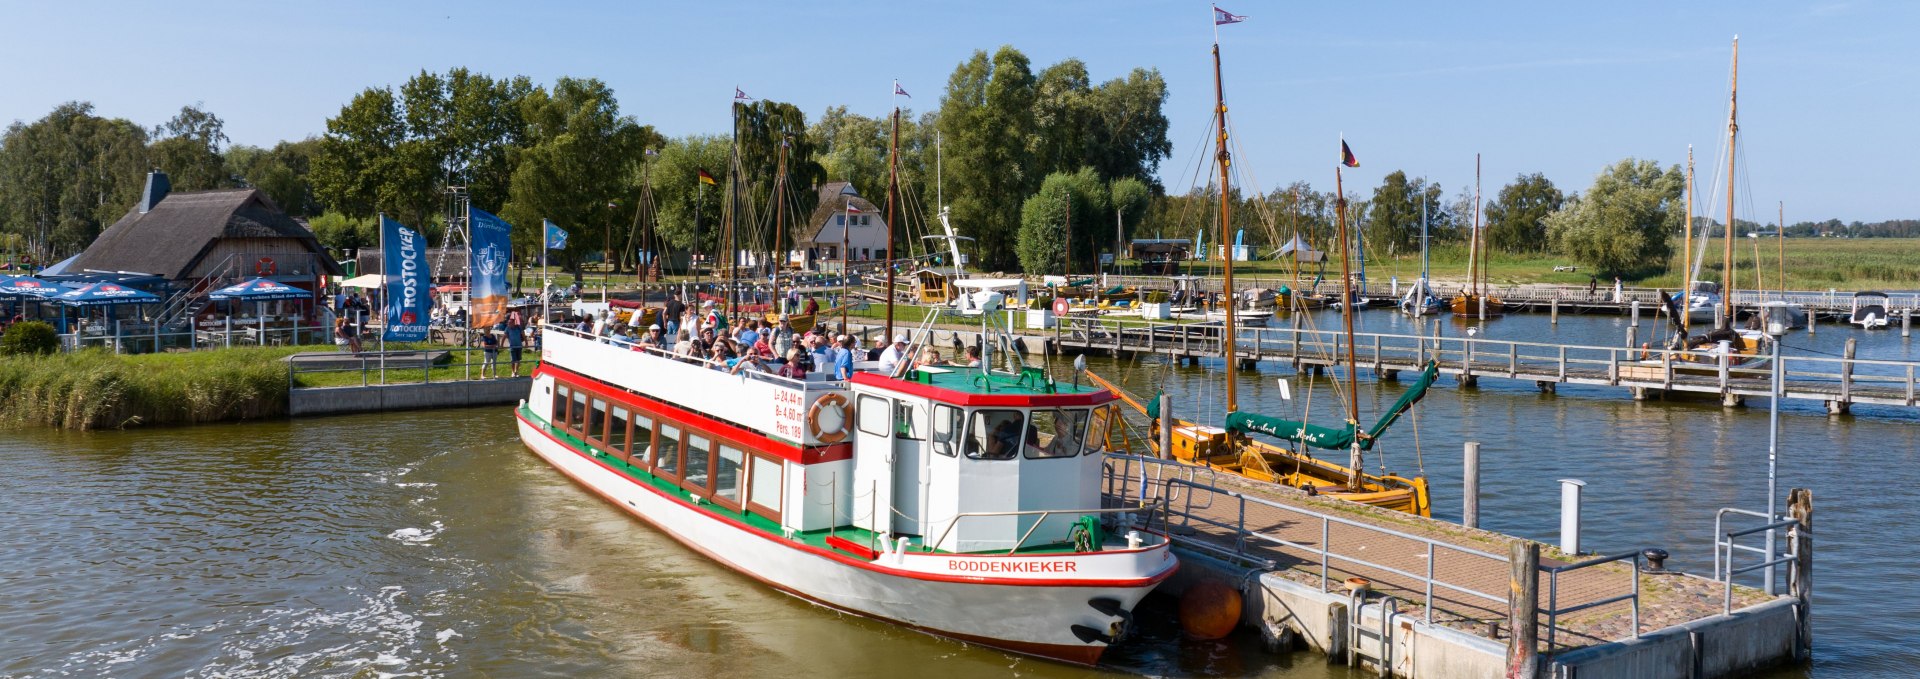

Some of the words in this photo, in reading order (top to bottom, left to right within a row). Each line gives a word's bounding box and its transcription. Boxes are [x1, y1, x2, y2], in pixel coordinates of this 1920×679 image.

[398, 226, 418, 308] ROSTOCKER
[774, 389, 780, 400] L=
[781, 390, 796, 405] 24,44
[798, 397, 802, 406] m
[775, 405, 782, 416] B=
[783, 407, 796, 420] 4,60
[797, 413, 802, 422] m
[777, 421, 789, 435] Pers.
[791, 425, 801, 439] 189
[948, 560, 1077, 573] BODDENKIEKER
